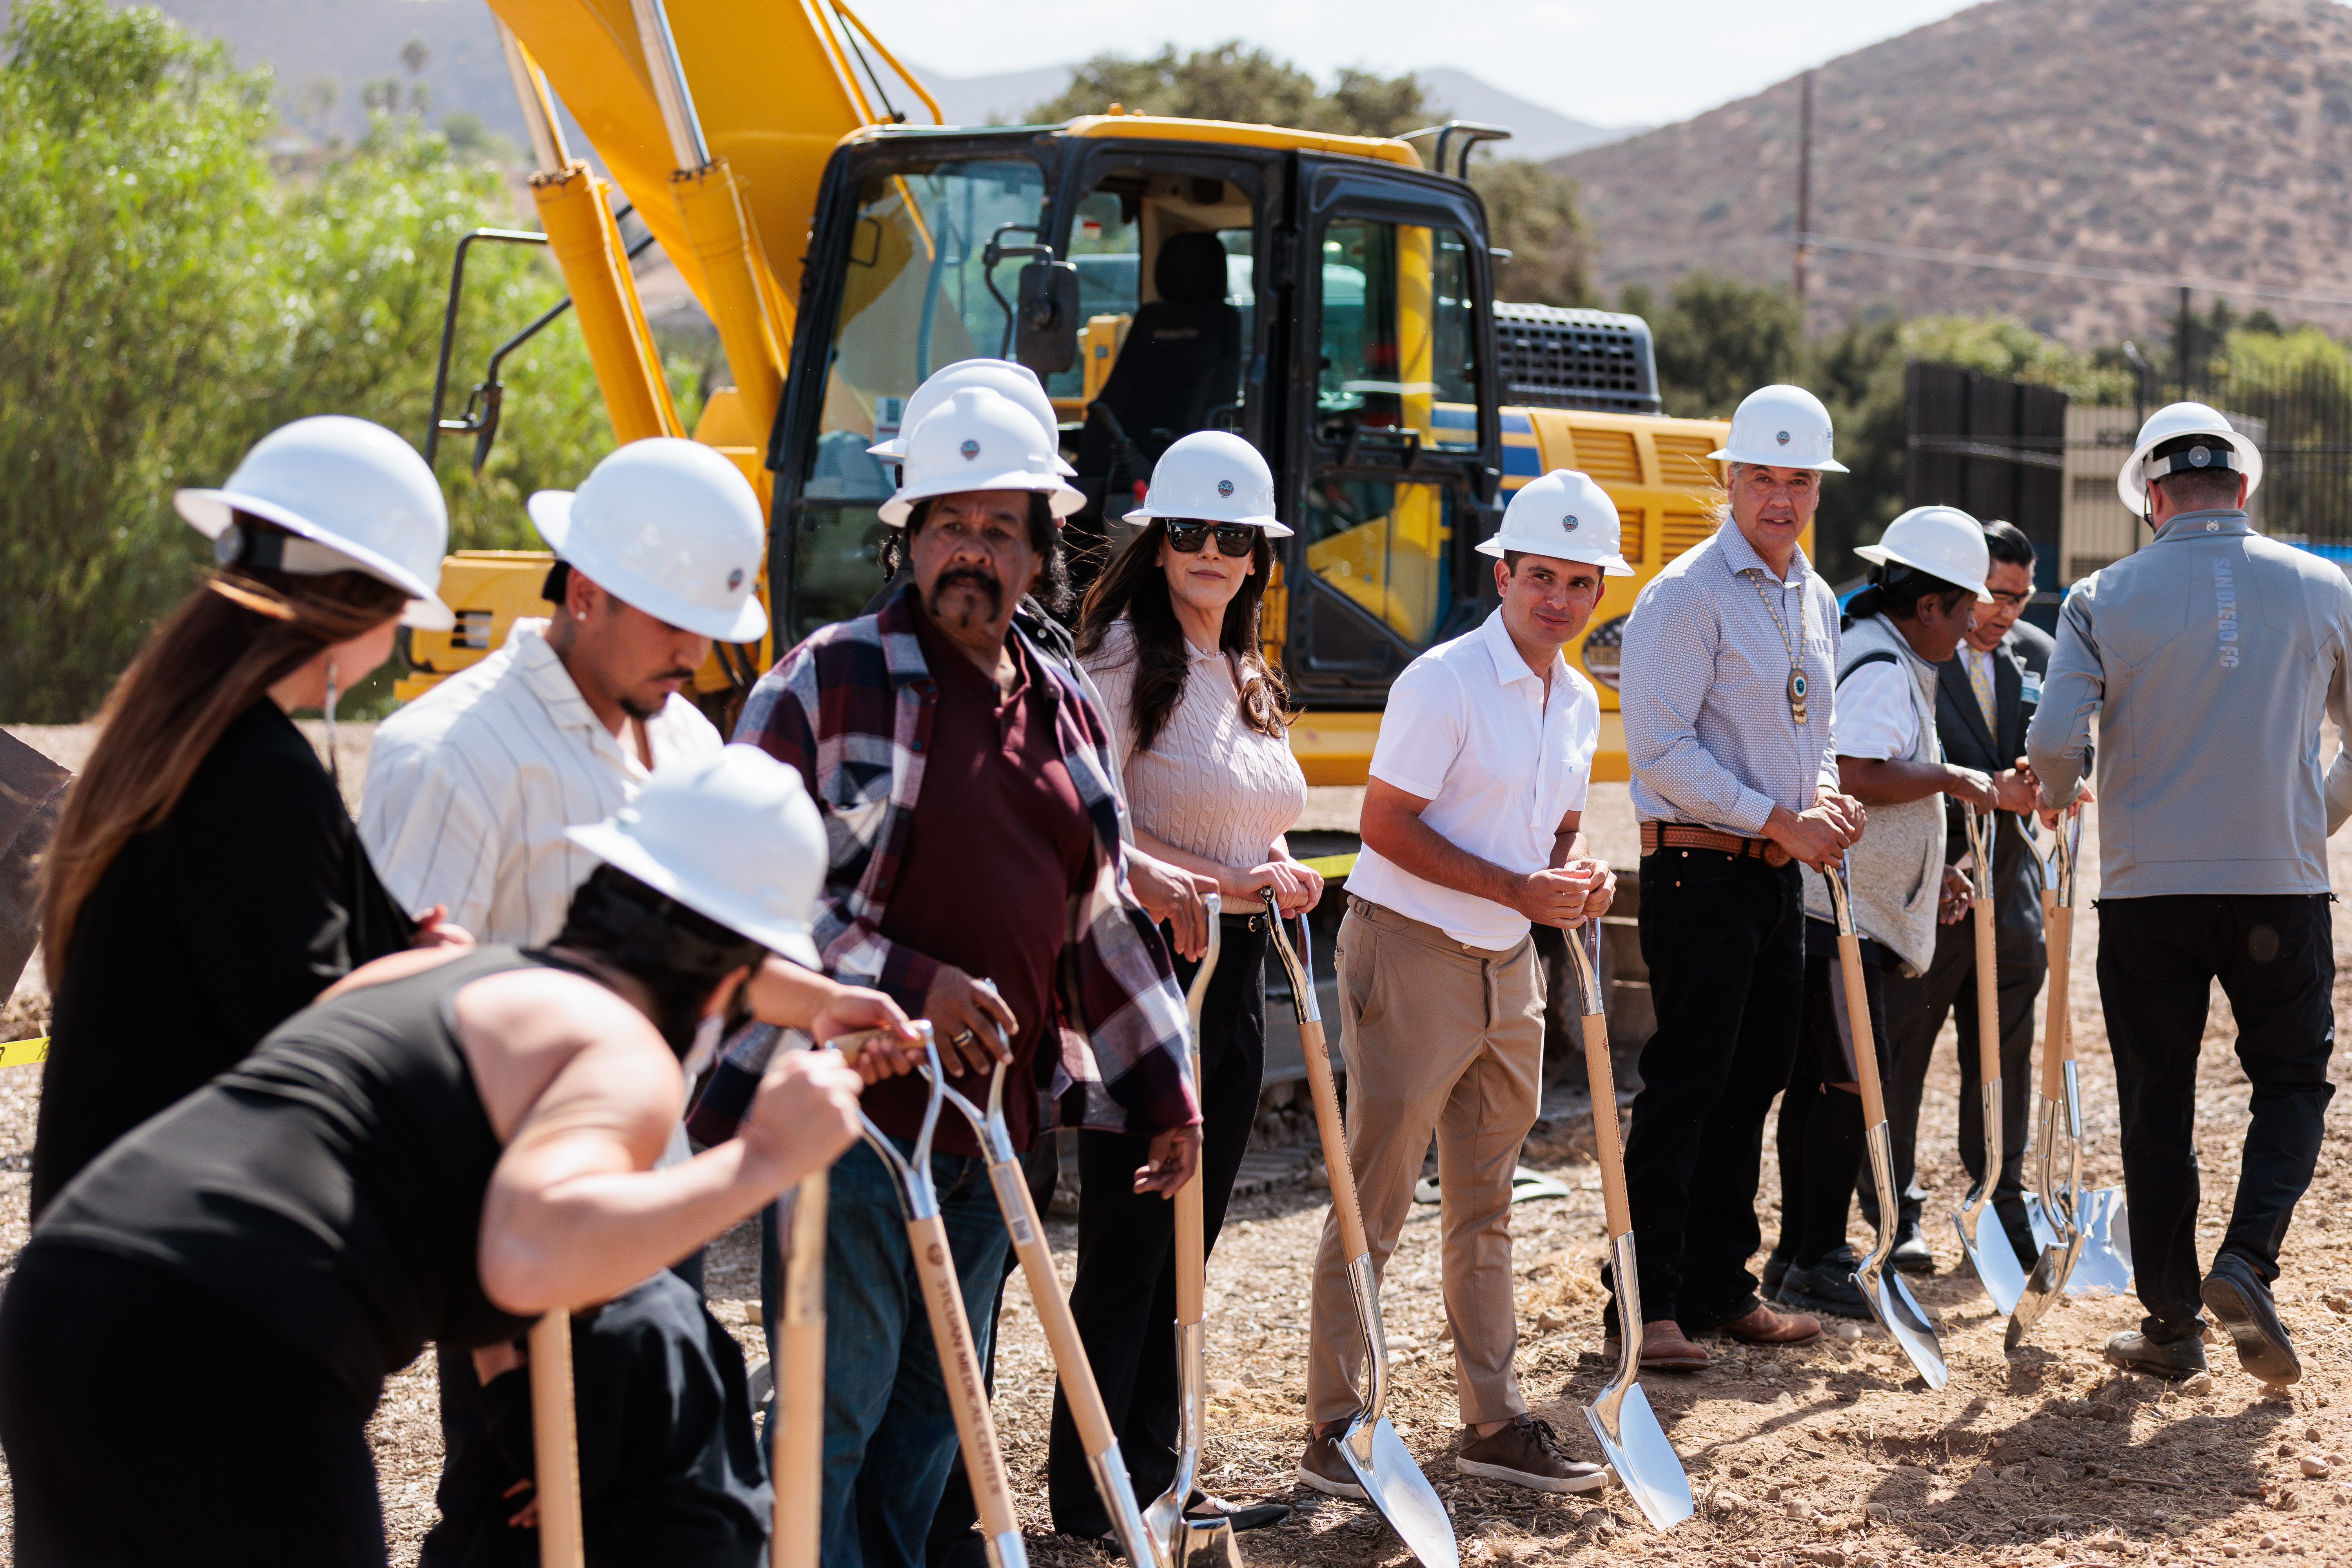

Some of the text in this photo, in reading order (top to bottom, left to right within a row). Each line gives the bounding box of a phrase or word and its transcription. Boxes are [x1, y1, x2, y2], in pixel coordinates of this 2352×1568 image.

[2212, 558, 2239, 667] SAN DIEGO FC
[1339, 1123, 1353, 1178] MEDICAL
[1351, 1181, 1364, 1229] CENTER
[956, 1352, 982, 1424] MEDICAL
[975, 1428, 1001, 1495] CENTER
